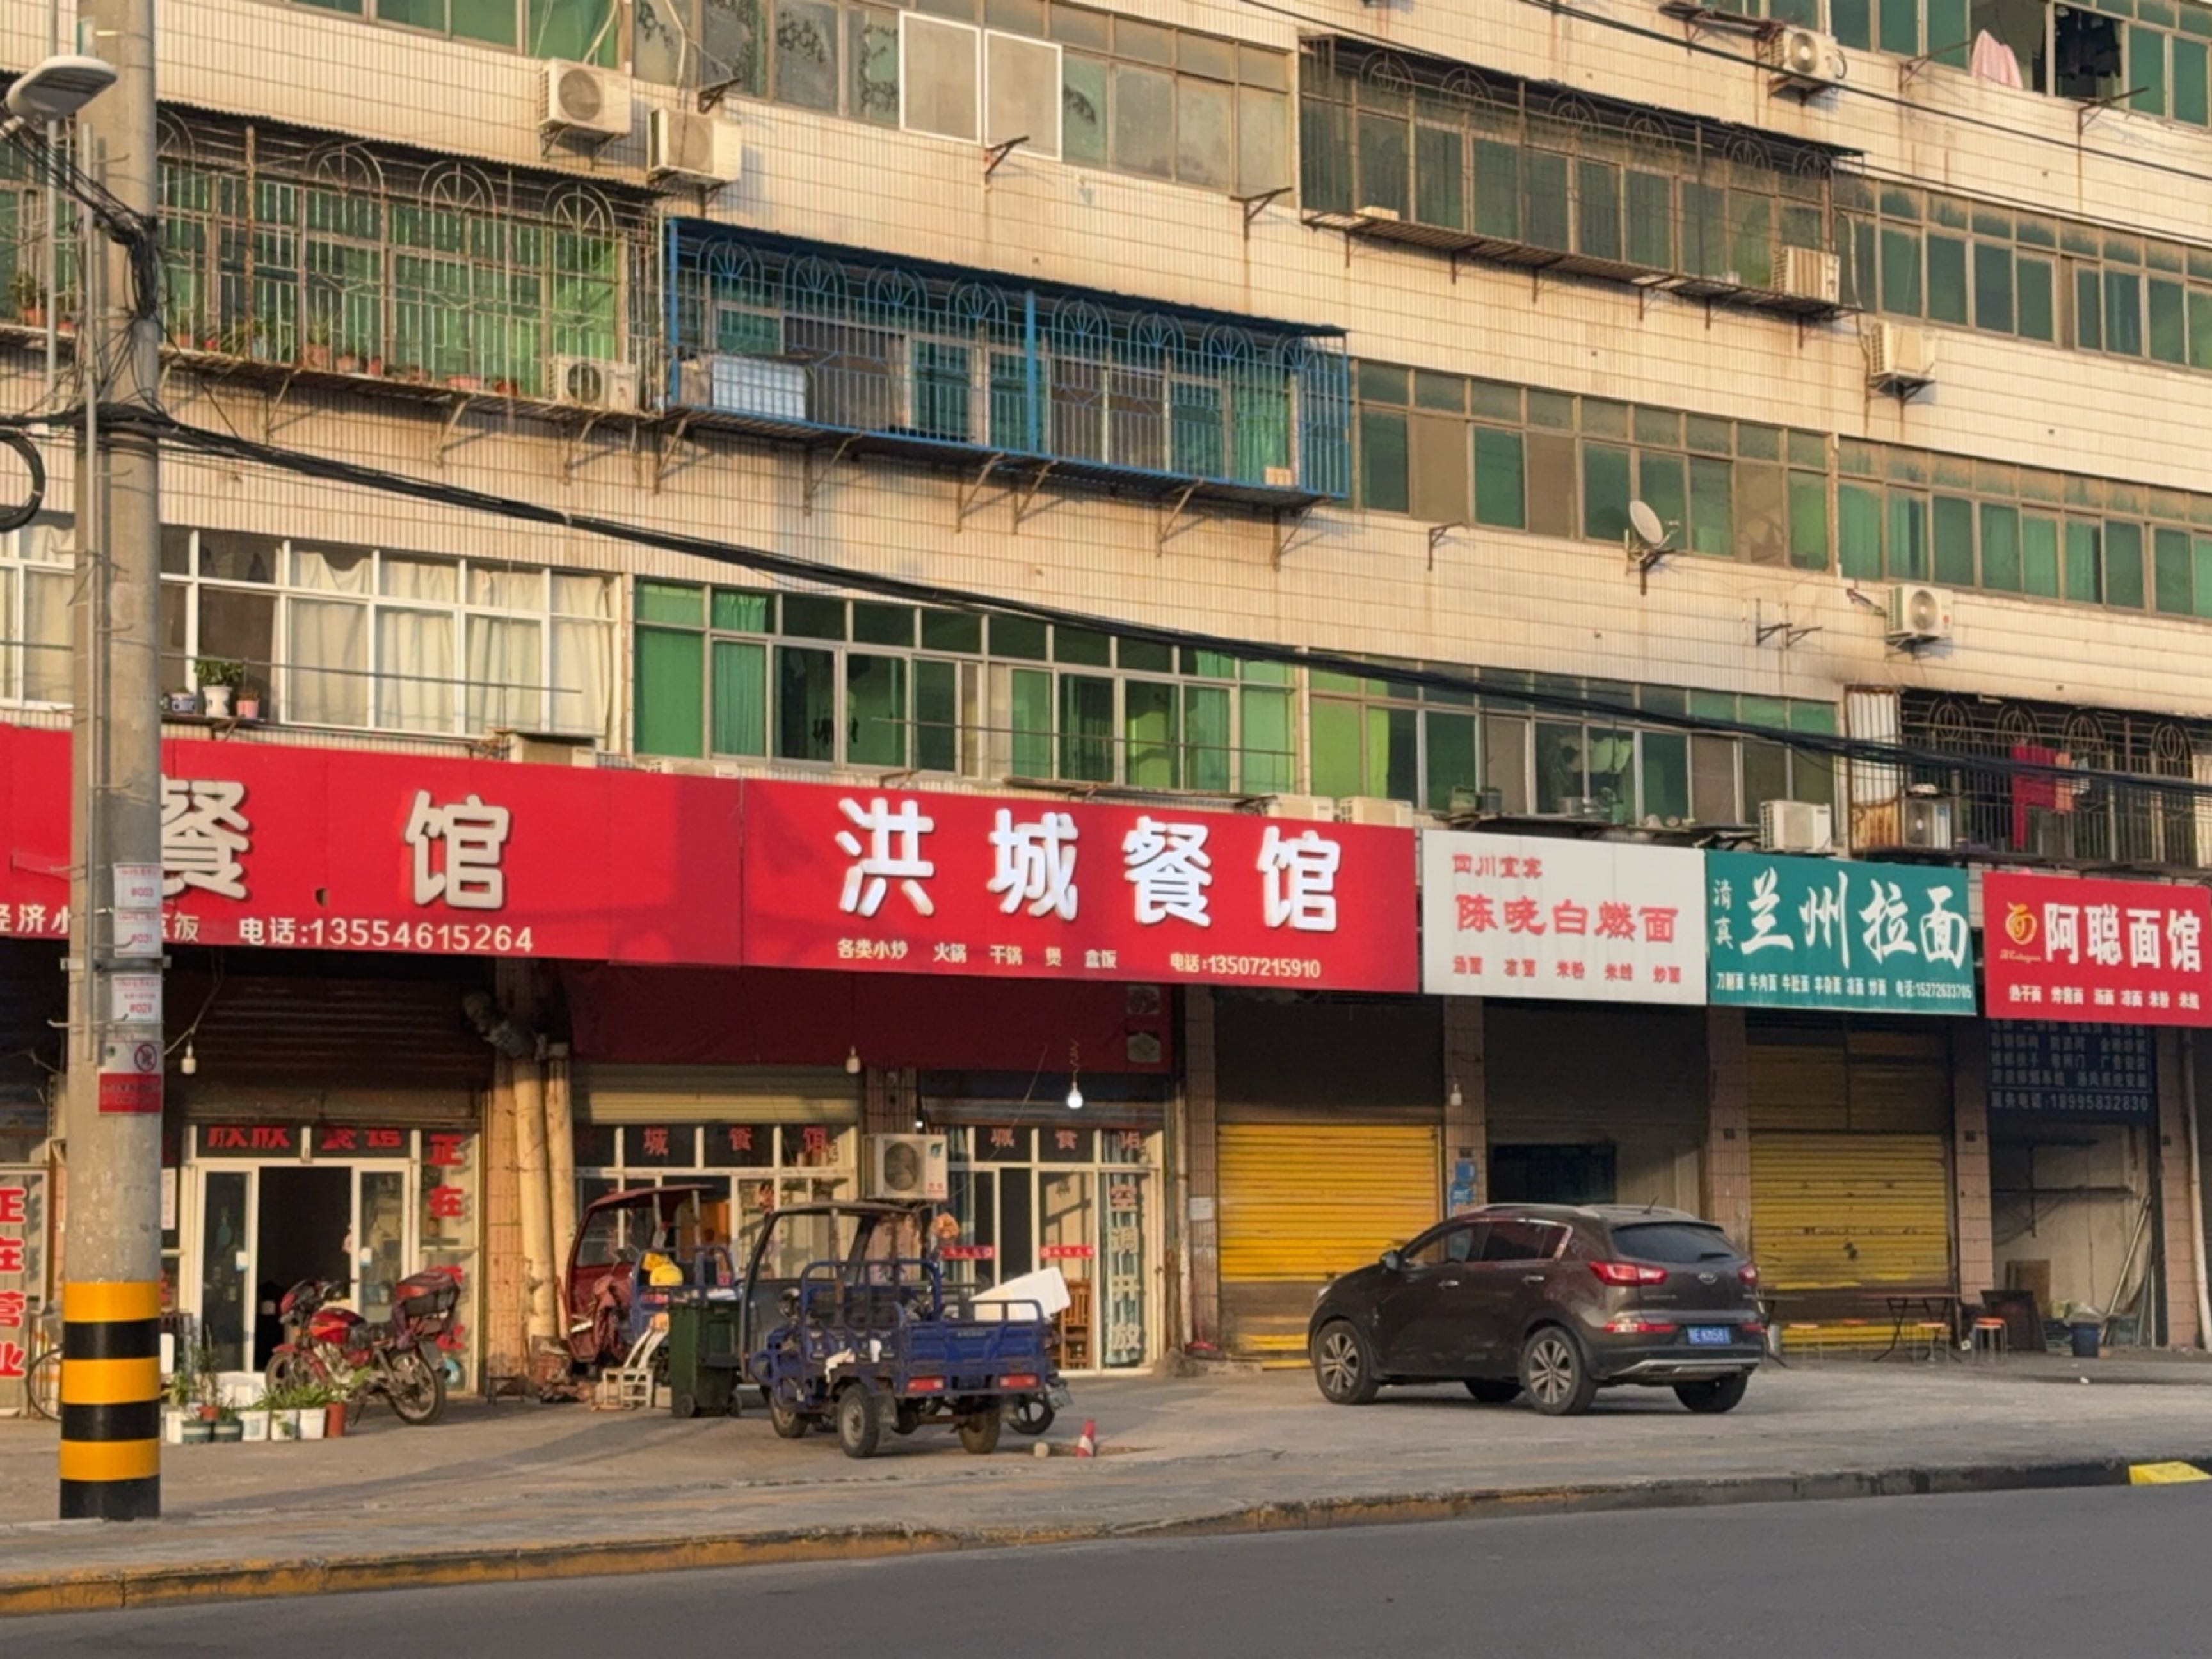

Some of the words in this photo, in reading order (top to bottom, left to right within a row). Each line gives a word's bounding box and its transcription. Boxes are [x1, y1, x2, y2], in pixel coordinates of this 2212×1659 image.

[835, 797, 1341, 933] 洪城餐馆
[1452, 854, 1543, 879] 四川宜宾
[239, 917, 534, 952] 电话:13554615264
[1454, 894, 1679, 943] 陈晓白燃面
[1713, 879, 1733, 949] 清真
[1740, 867, 1968, 970] 兰州拉面
[2044, 902, 2202, 972] 阿聪面馆
[837, 938, 909, 960] 各类小炒
[933, 942, 967, 963] 火锅
[990, 944, 1022, 965] 干锅
[1084, 949, 1117, 969] 盒饭
[1170, 952, 1321, 978] 电话:13507215910
[1110, 1185, 1140, 1350] 空调开放
